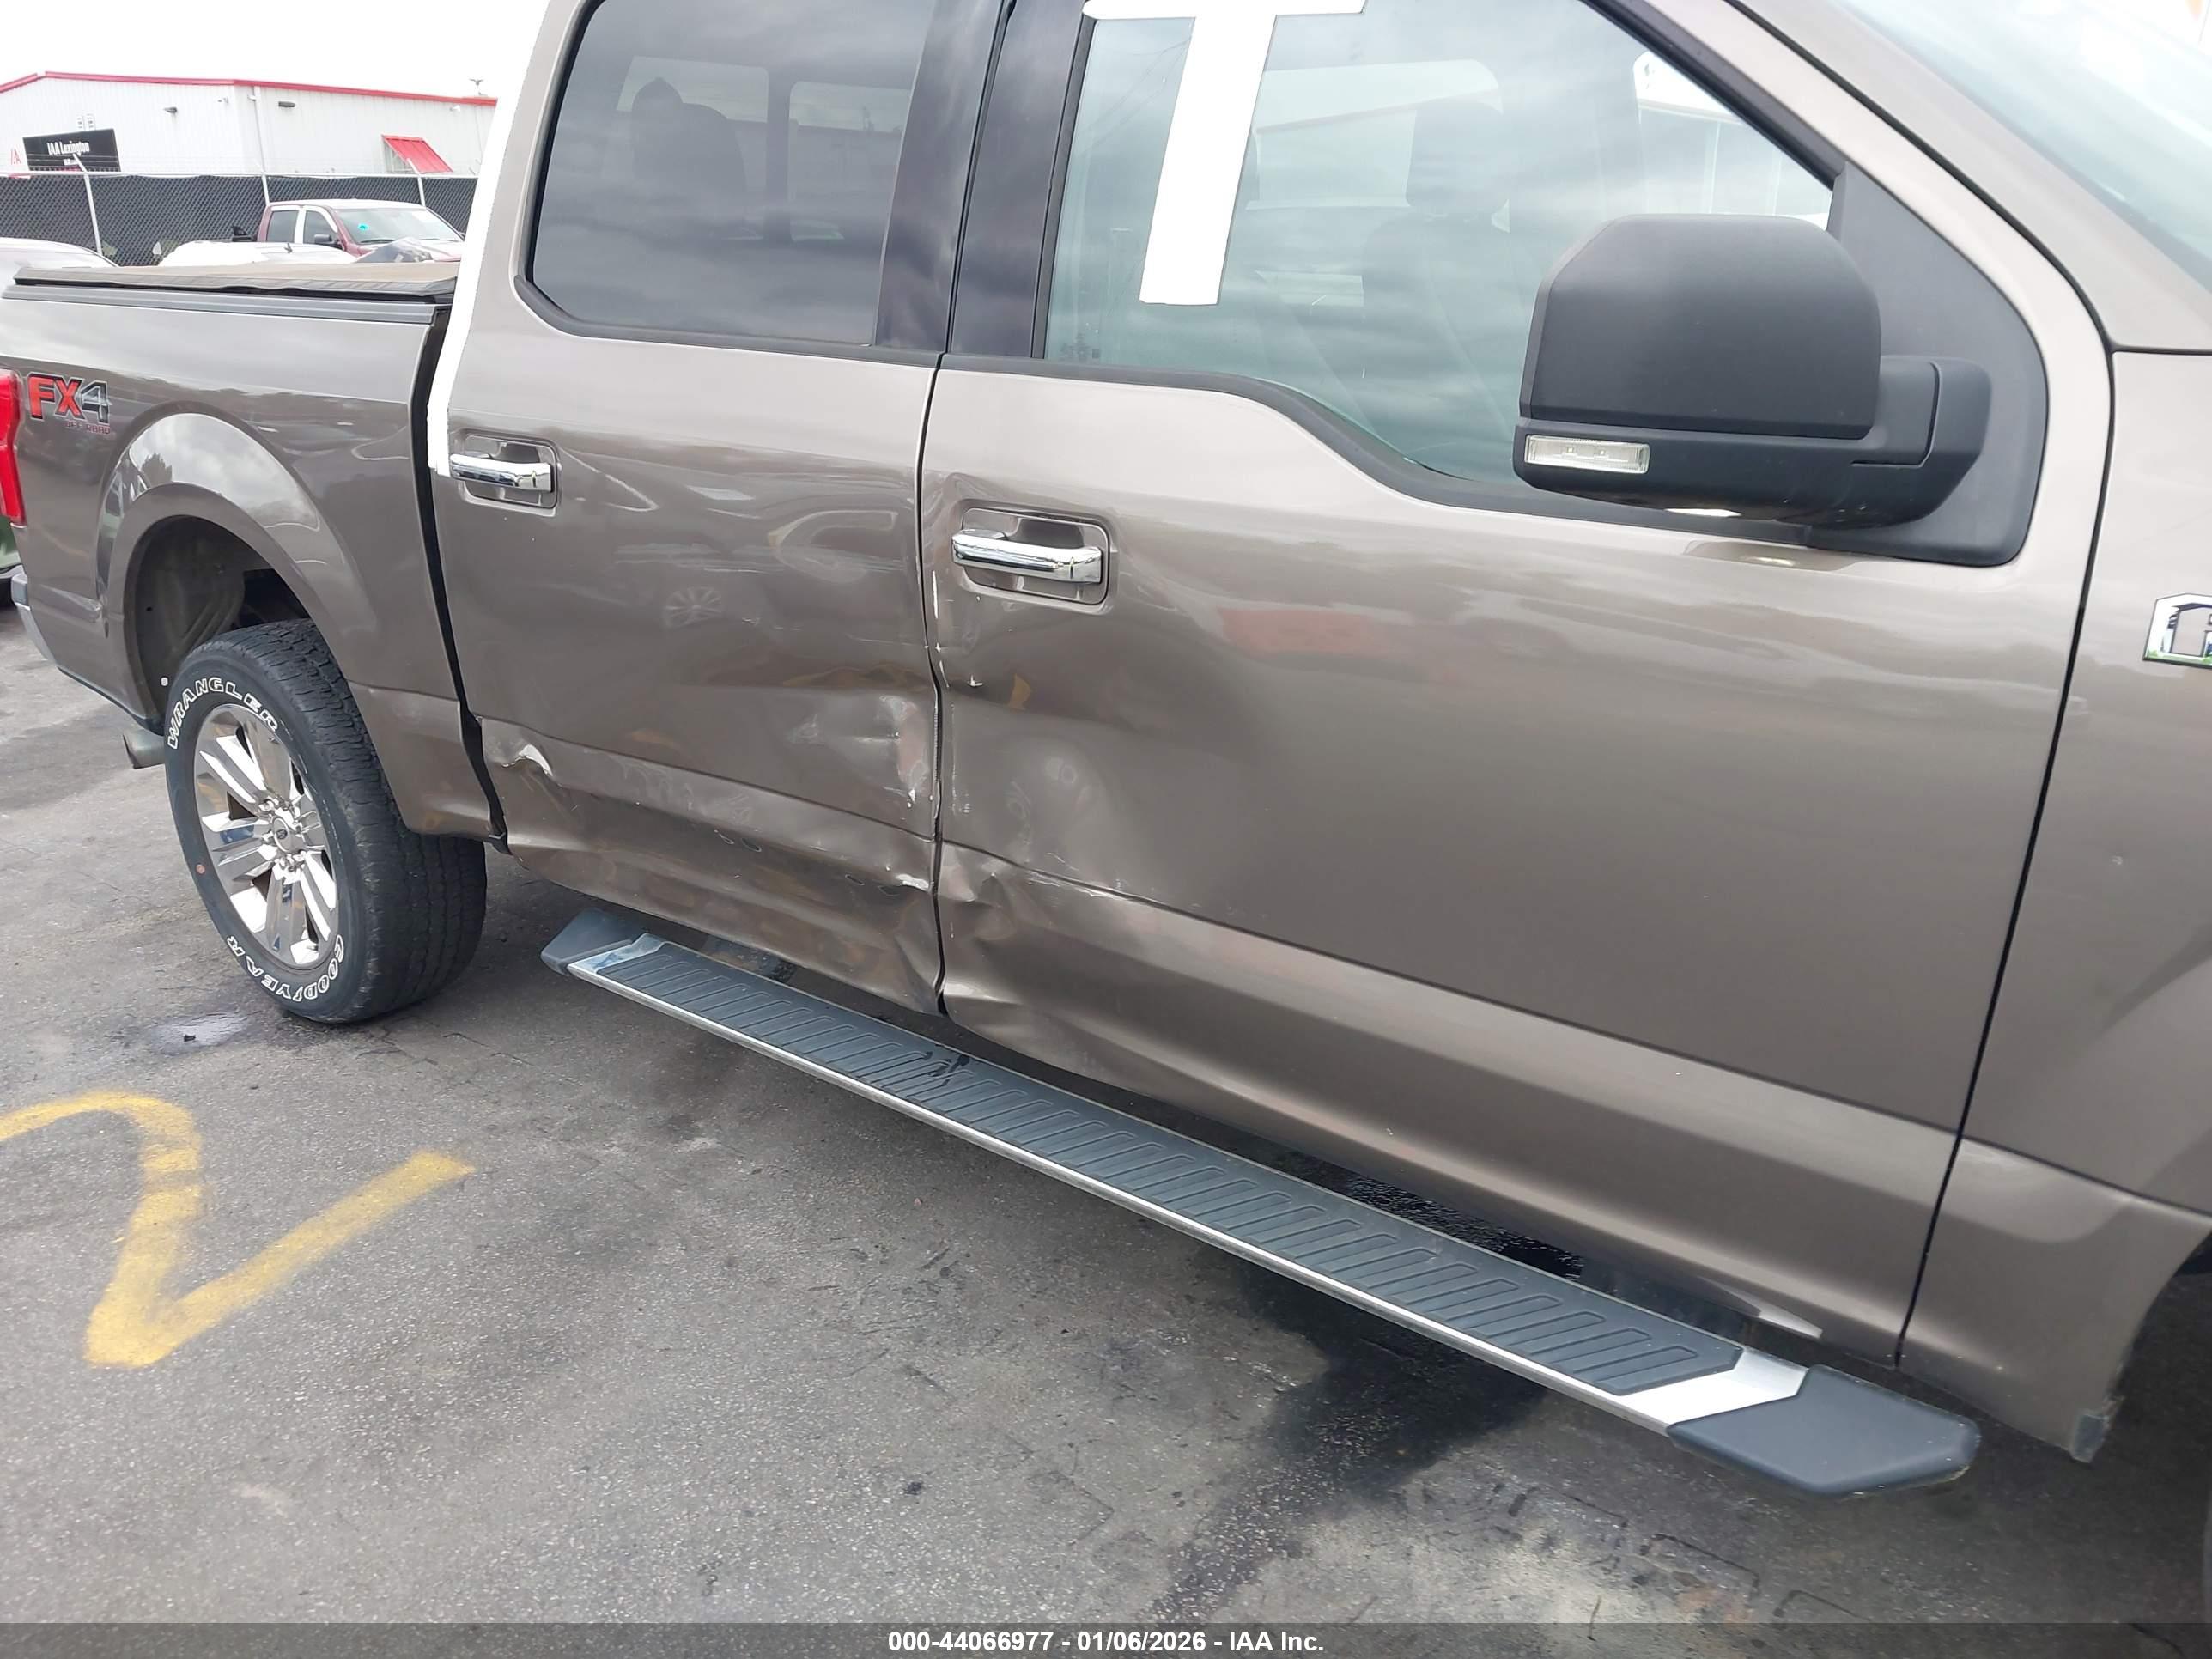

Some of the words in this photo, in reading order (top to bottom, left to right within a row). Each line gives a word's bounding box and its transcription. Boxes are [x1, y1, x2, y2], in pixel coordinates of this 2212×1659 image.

[47, 142, 61, 155] IAA
[59, 140, 90, 156] Lexington
[27, 371, 112, 426] FX4
[167, 677, 278, 750] WRANGLER
[227, 934, 344, 1002] GOODYEAR
